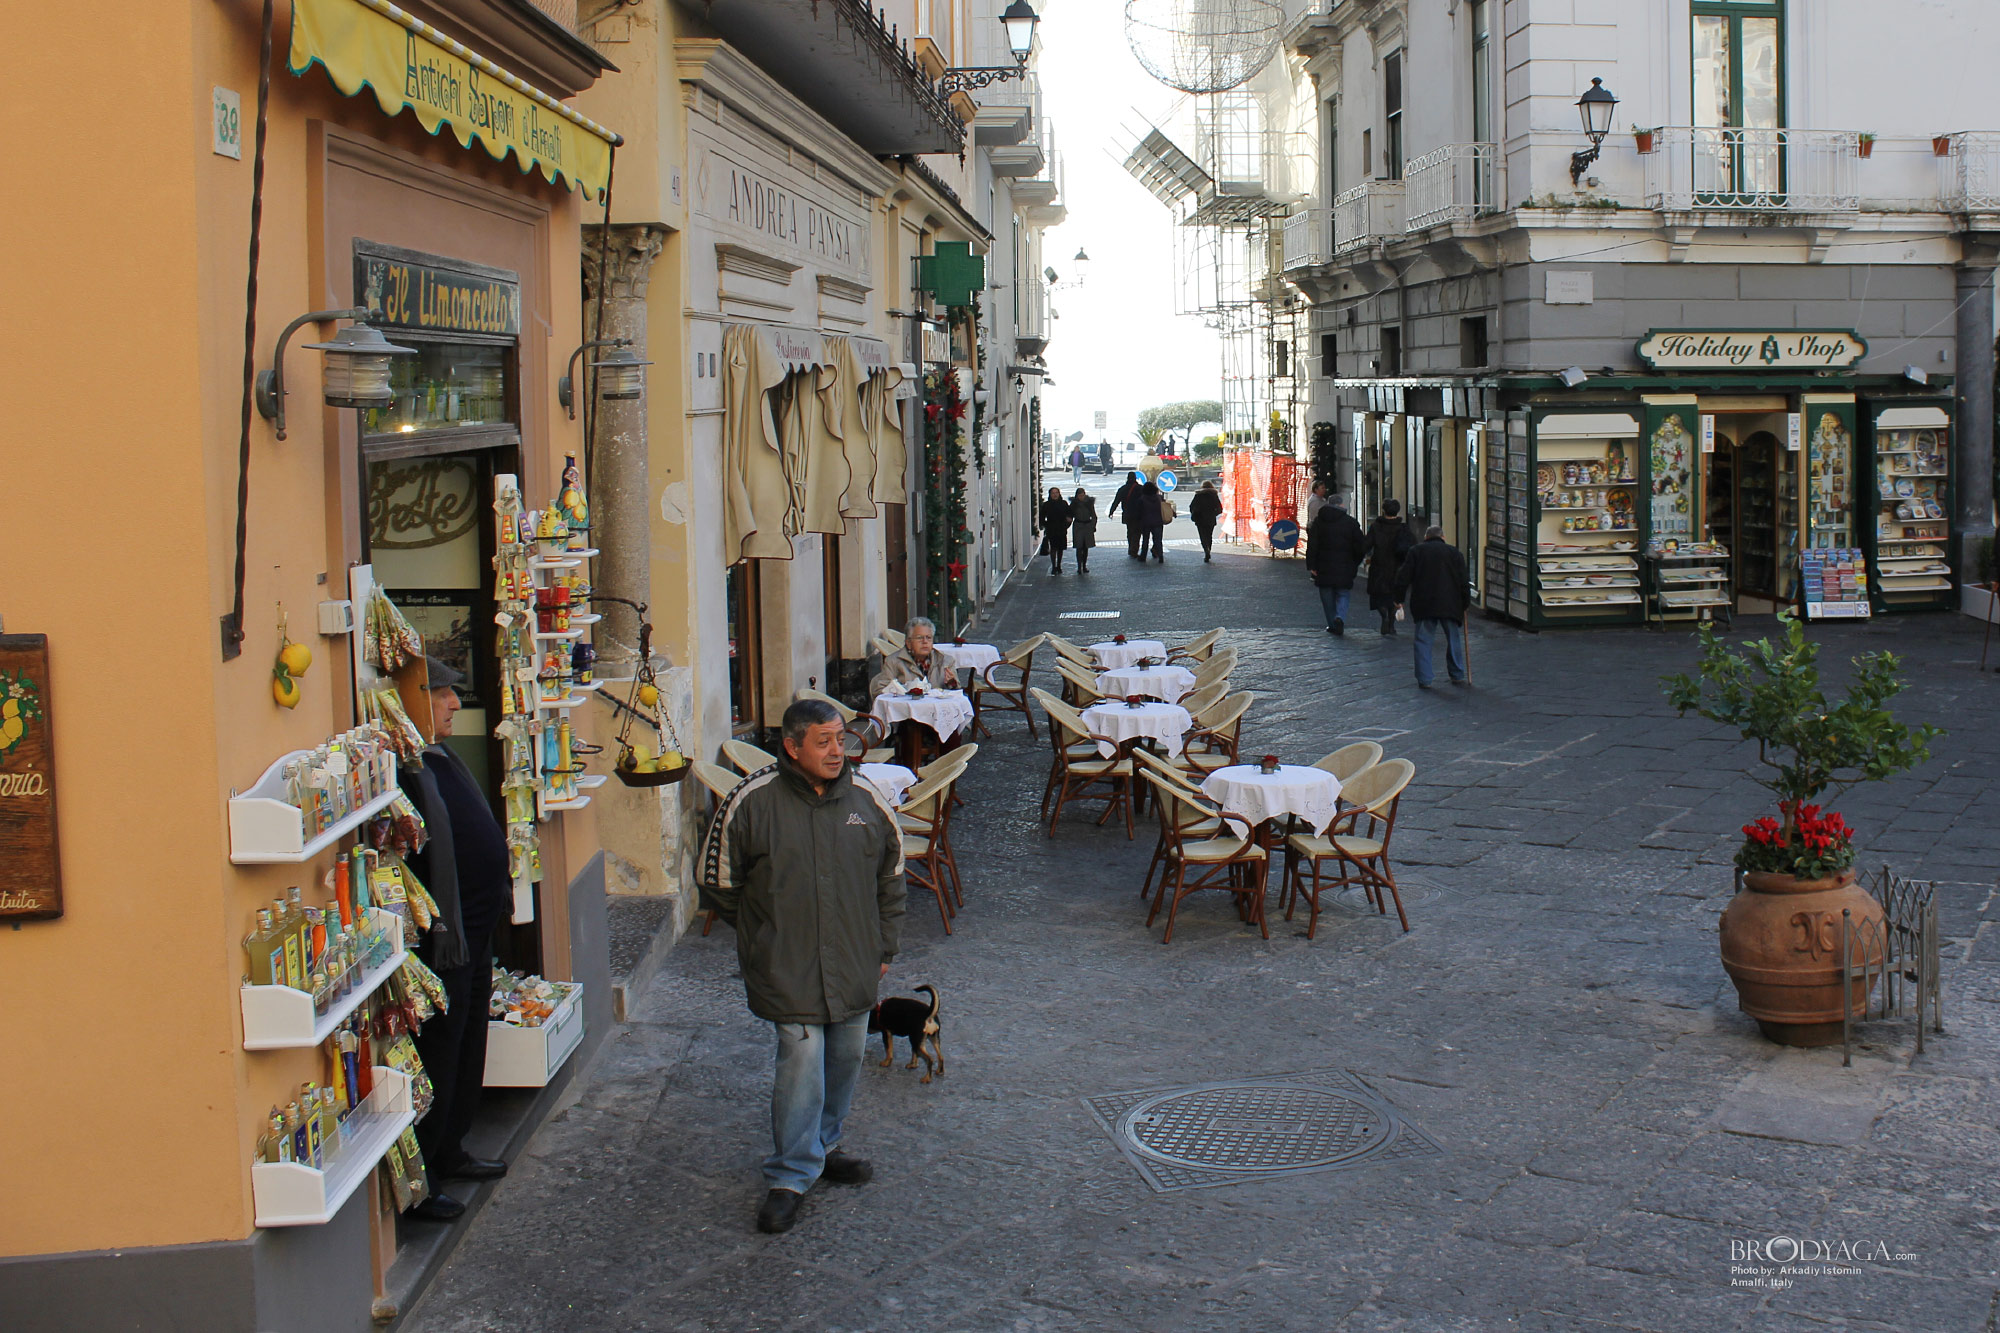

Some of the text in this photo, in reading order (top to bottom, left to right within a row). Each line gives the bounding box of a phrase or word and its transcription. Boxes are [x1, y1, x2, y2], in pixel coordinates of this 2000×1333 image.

[405, 29, 462, 117] Antichi
[469, 64, 515, 140] Sapori
[219, 102, 238, 145] 39
[728, 169, 851, 265] ANDREA PANSA
[419, 269, 508, 332] Limoncello
[1657, 335, 1847, 365] Holiday Shop
